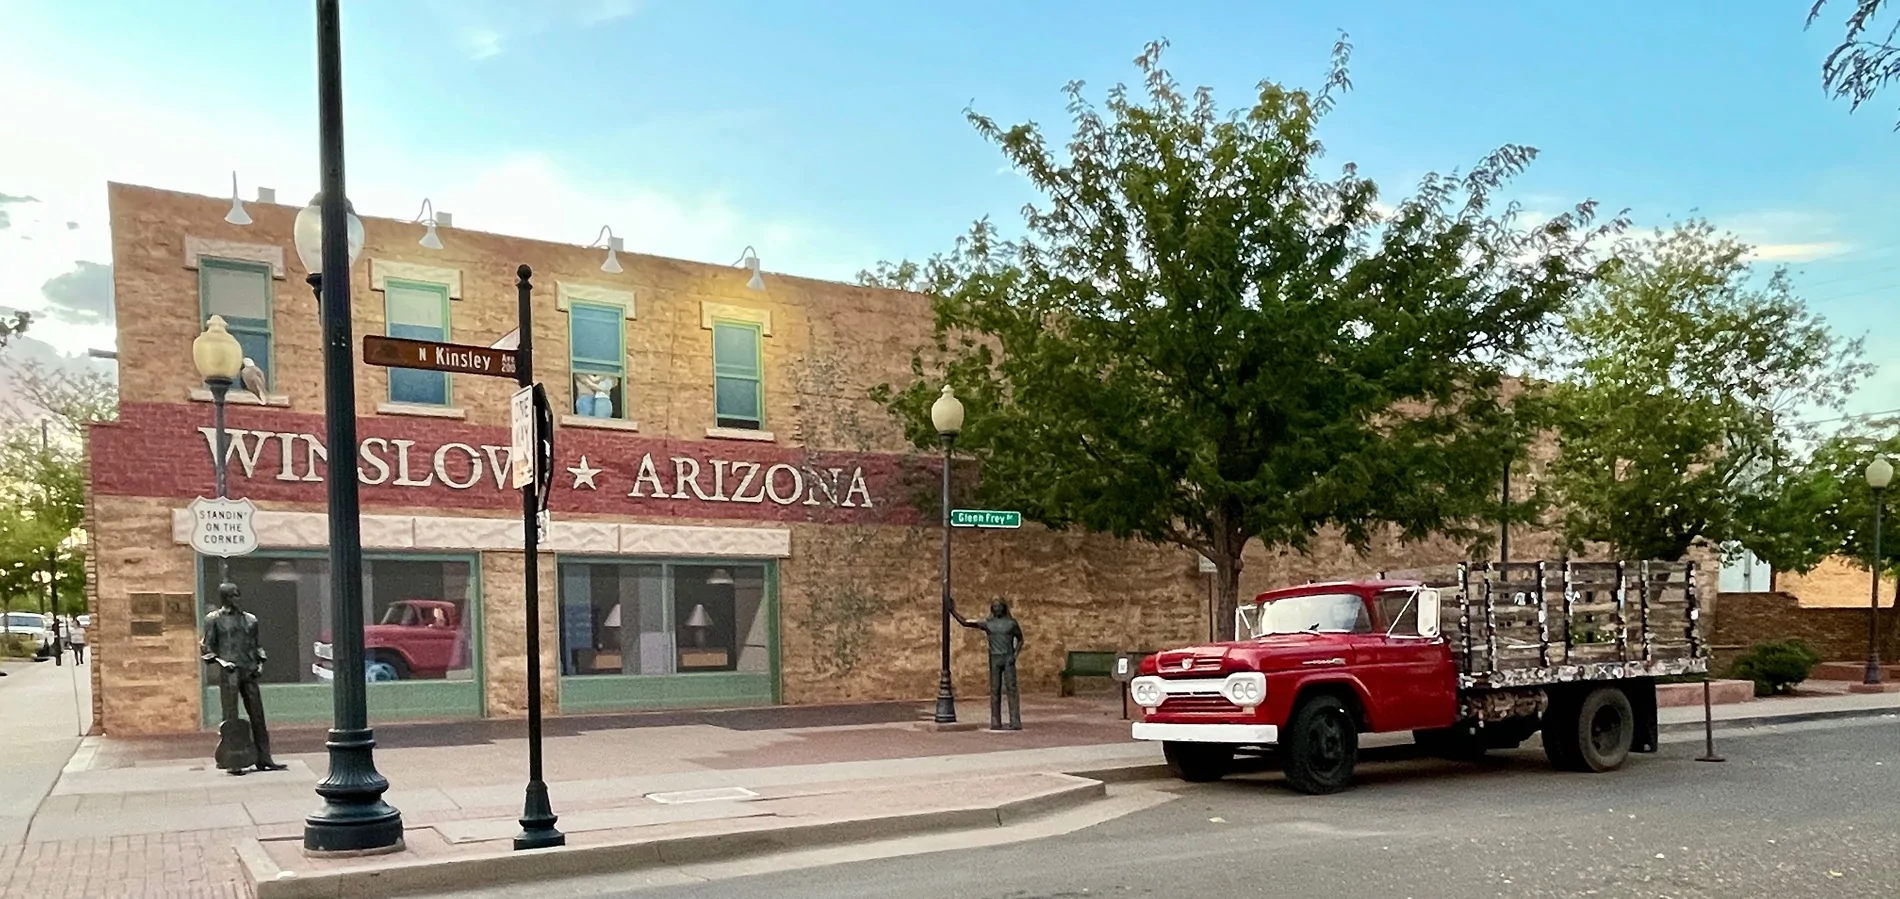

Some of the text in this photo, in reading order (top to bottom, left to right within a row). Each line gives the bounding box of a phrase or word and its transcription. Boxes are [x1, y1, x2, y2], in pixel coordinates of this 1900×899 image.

[418, 346, 516, 371] N Kinsley Ave
[501, 363, 516, 373] 200
[627, 452, 873, 508] ARIZONA
[199, 510, 247, 520] STANDIN'
[958, 512, 984, 522] Glenn
[985, 512, 1005, 524] Frey
[205, 522, 242, 532] ON THE
[204, 534, 245, 544] CORNER
